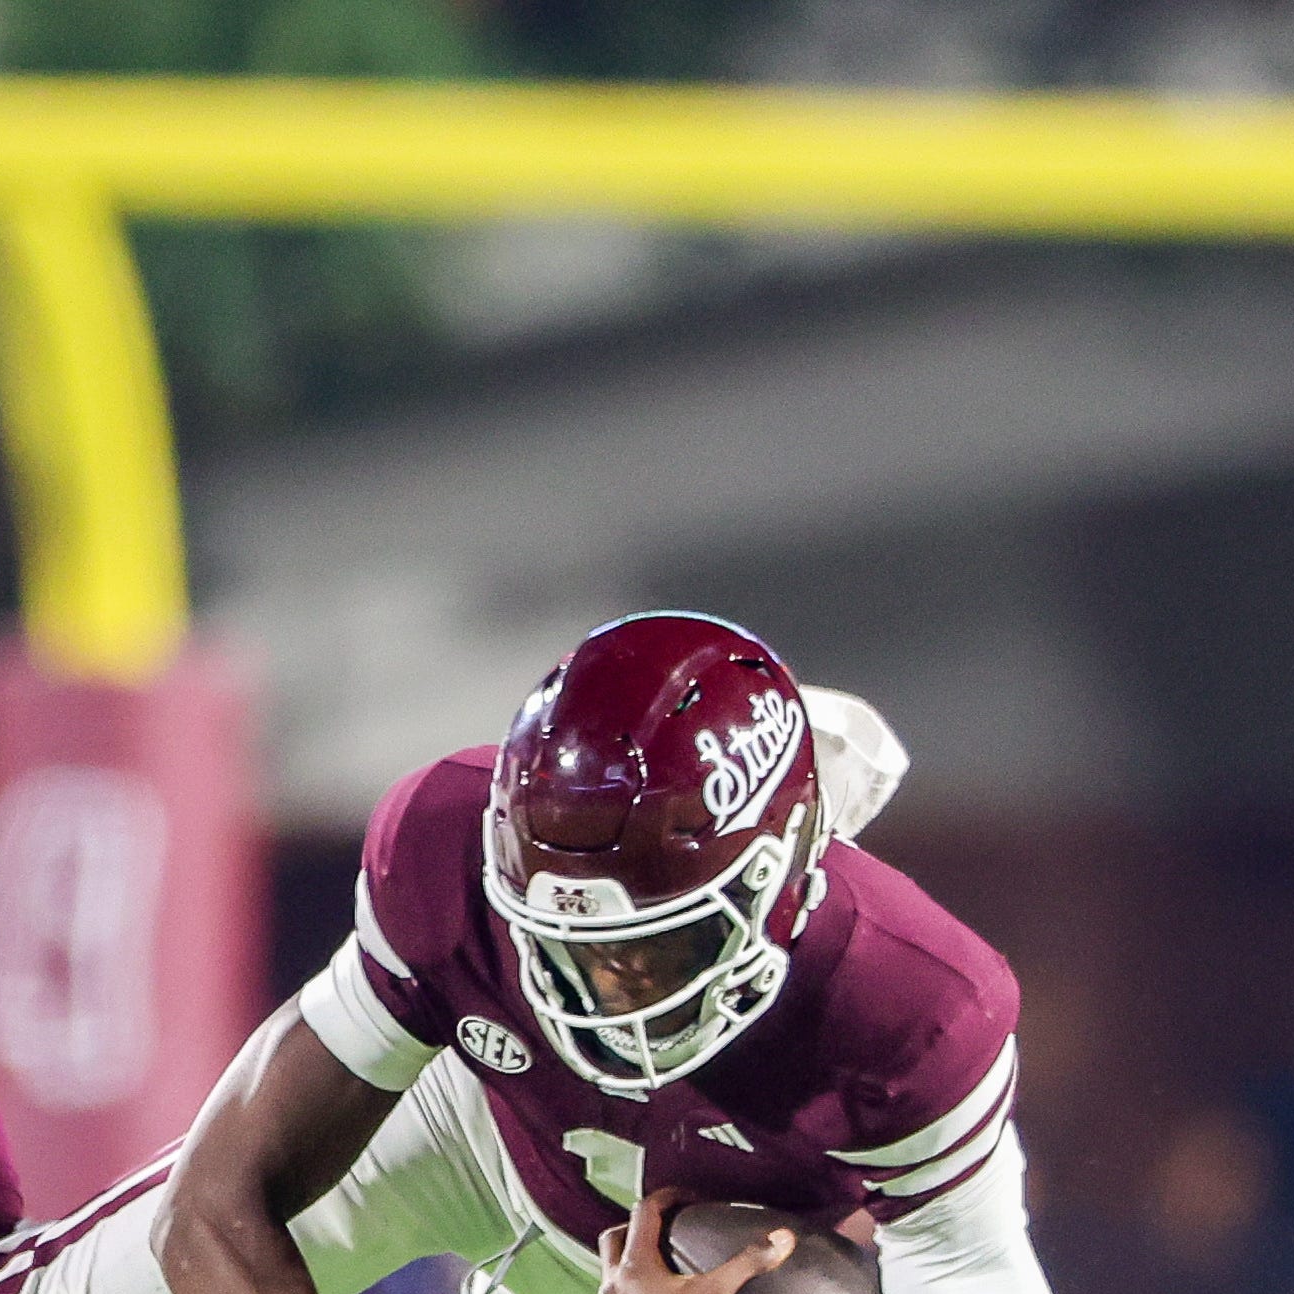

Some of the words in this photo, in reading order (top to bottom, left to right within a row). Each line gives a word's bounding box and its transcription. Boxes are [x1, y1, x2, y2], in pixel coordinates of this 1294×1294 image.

[695, 690, 804, 837] State
[464, 1022, 524, 1069] SEC
[563, 1128, 645, 1212] 1
